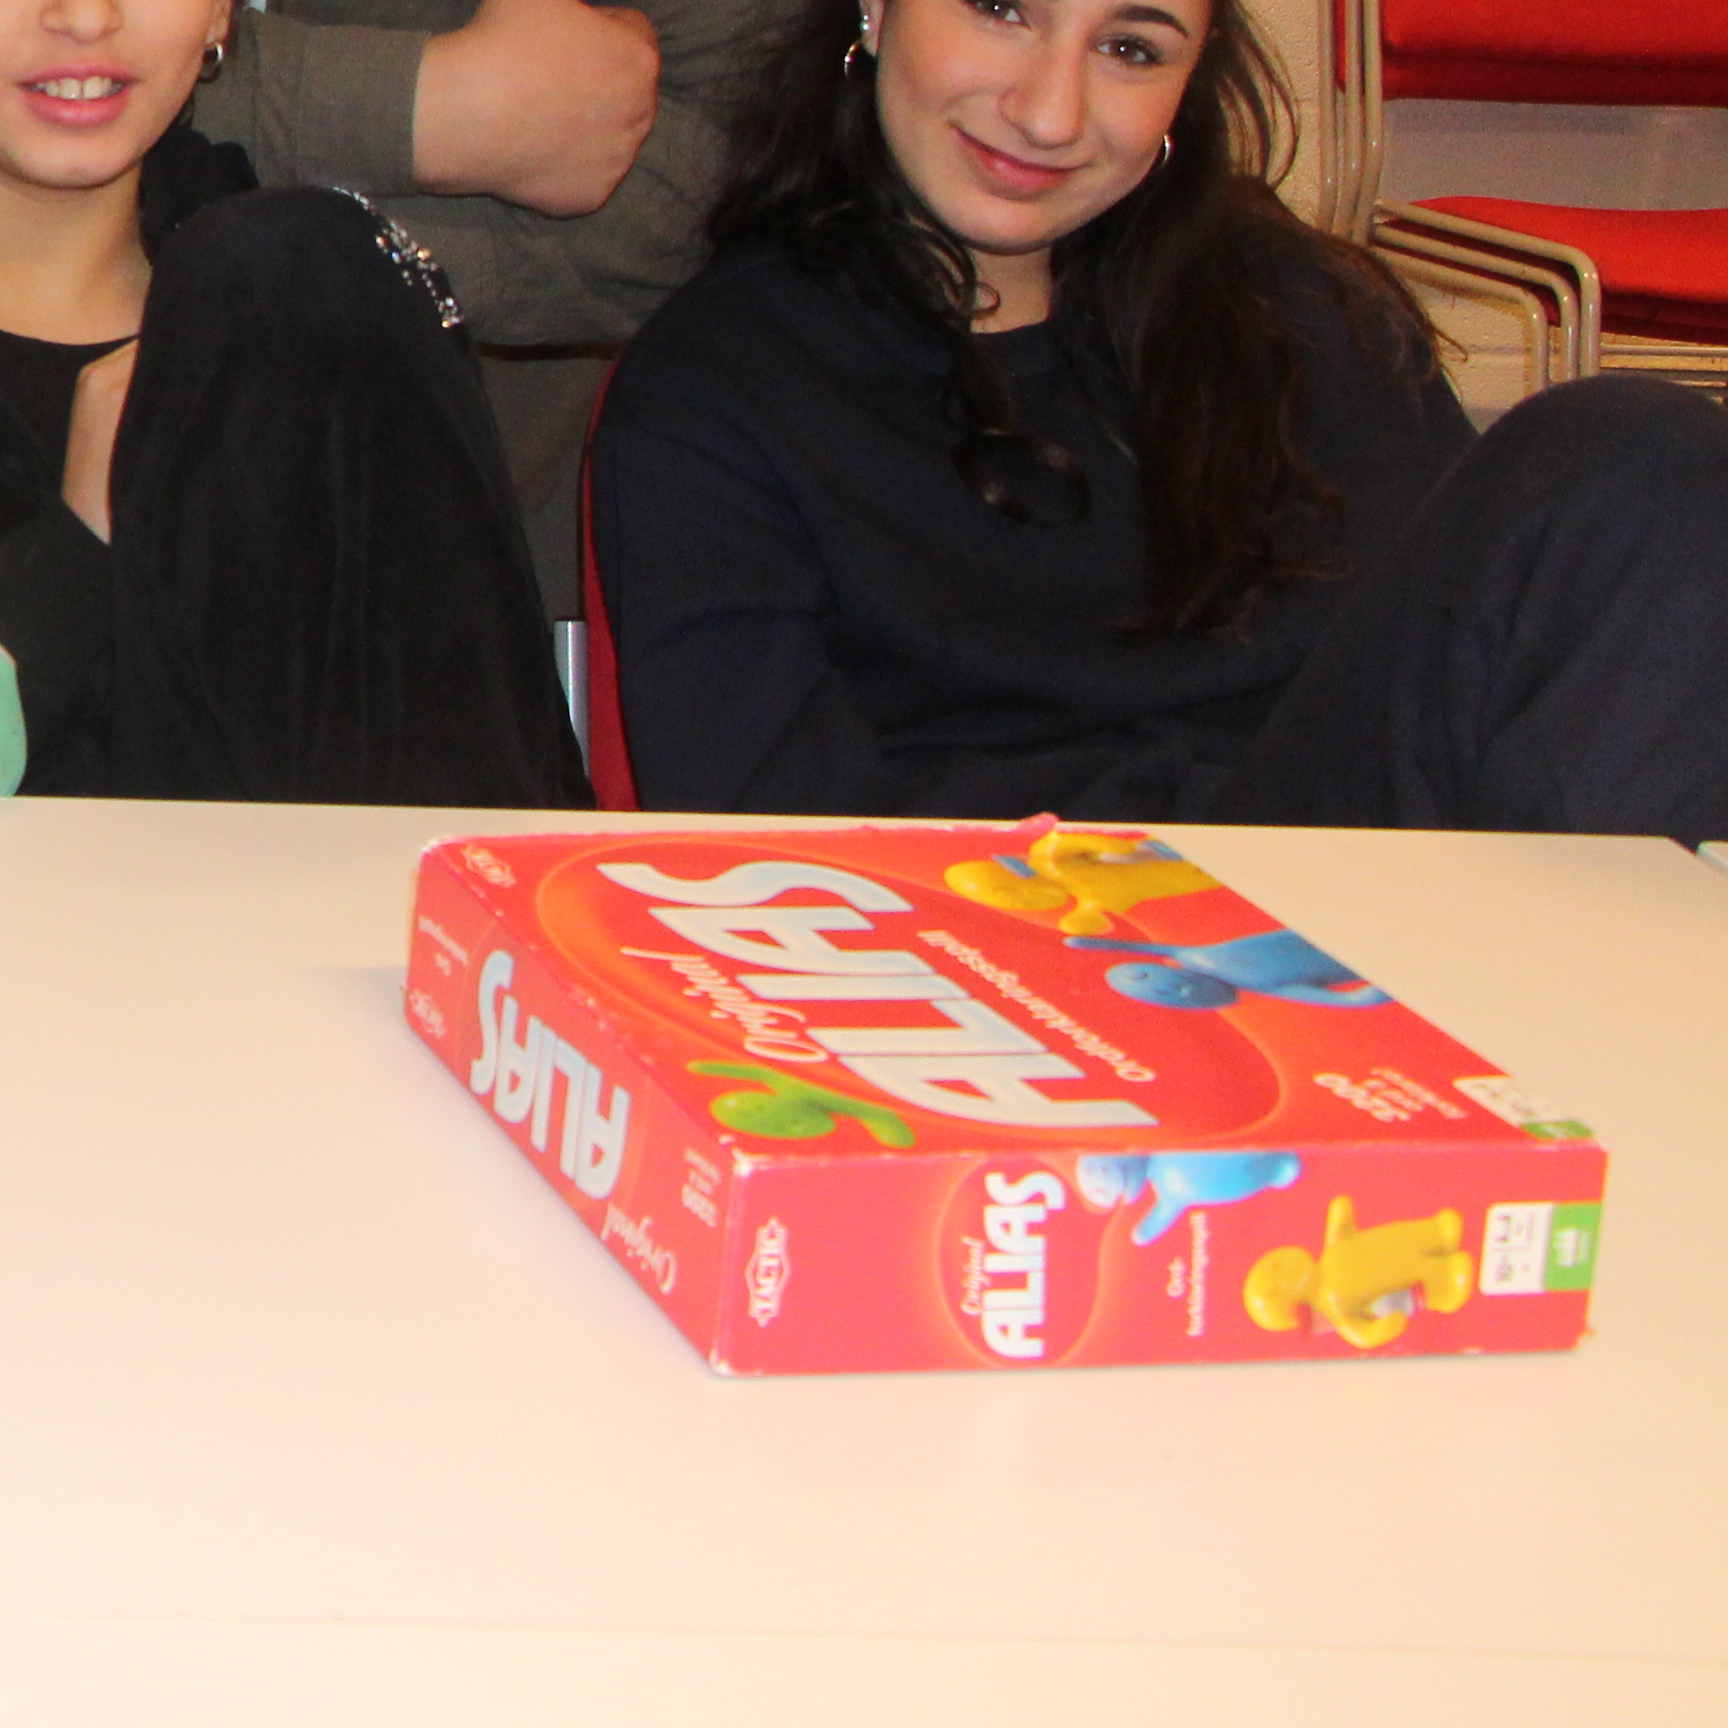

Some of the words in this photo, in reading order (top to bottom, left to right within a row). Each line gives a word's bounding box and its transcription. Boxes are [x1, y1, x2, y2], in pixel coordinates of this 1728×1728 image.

[596, 860, 1160, 1127] ALIAS
[620, 945, 829, 1064] Original
[470, 950, 631, 1200] ALIAS
[600, 1202, 677, 1295] Original
[960, 1235, 992, 1316] Original
[981, 1171, 1066, 1359] ALIAS
